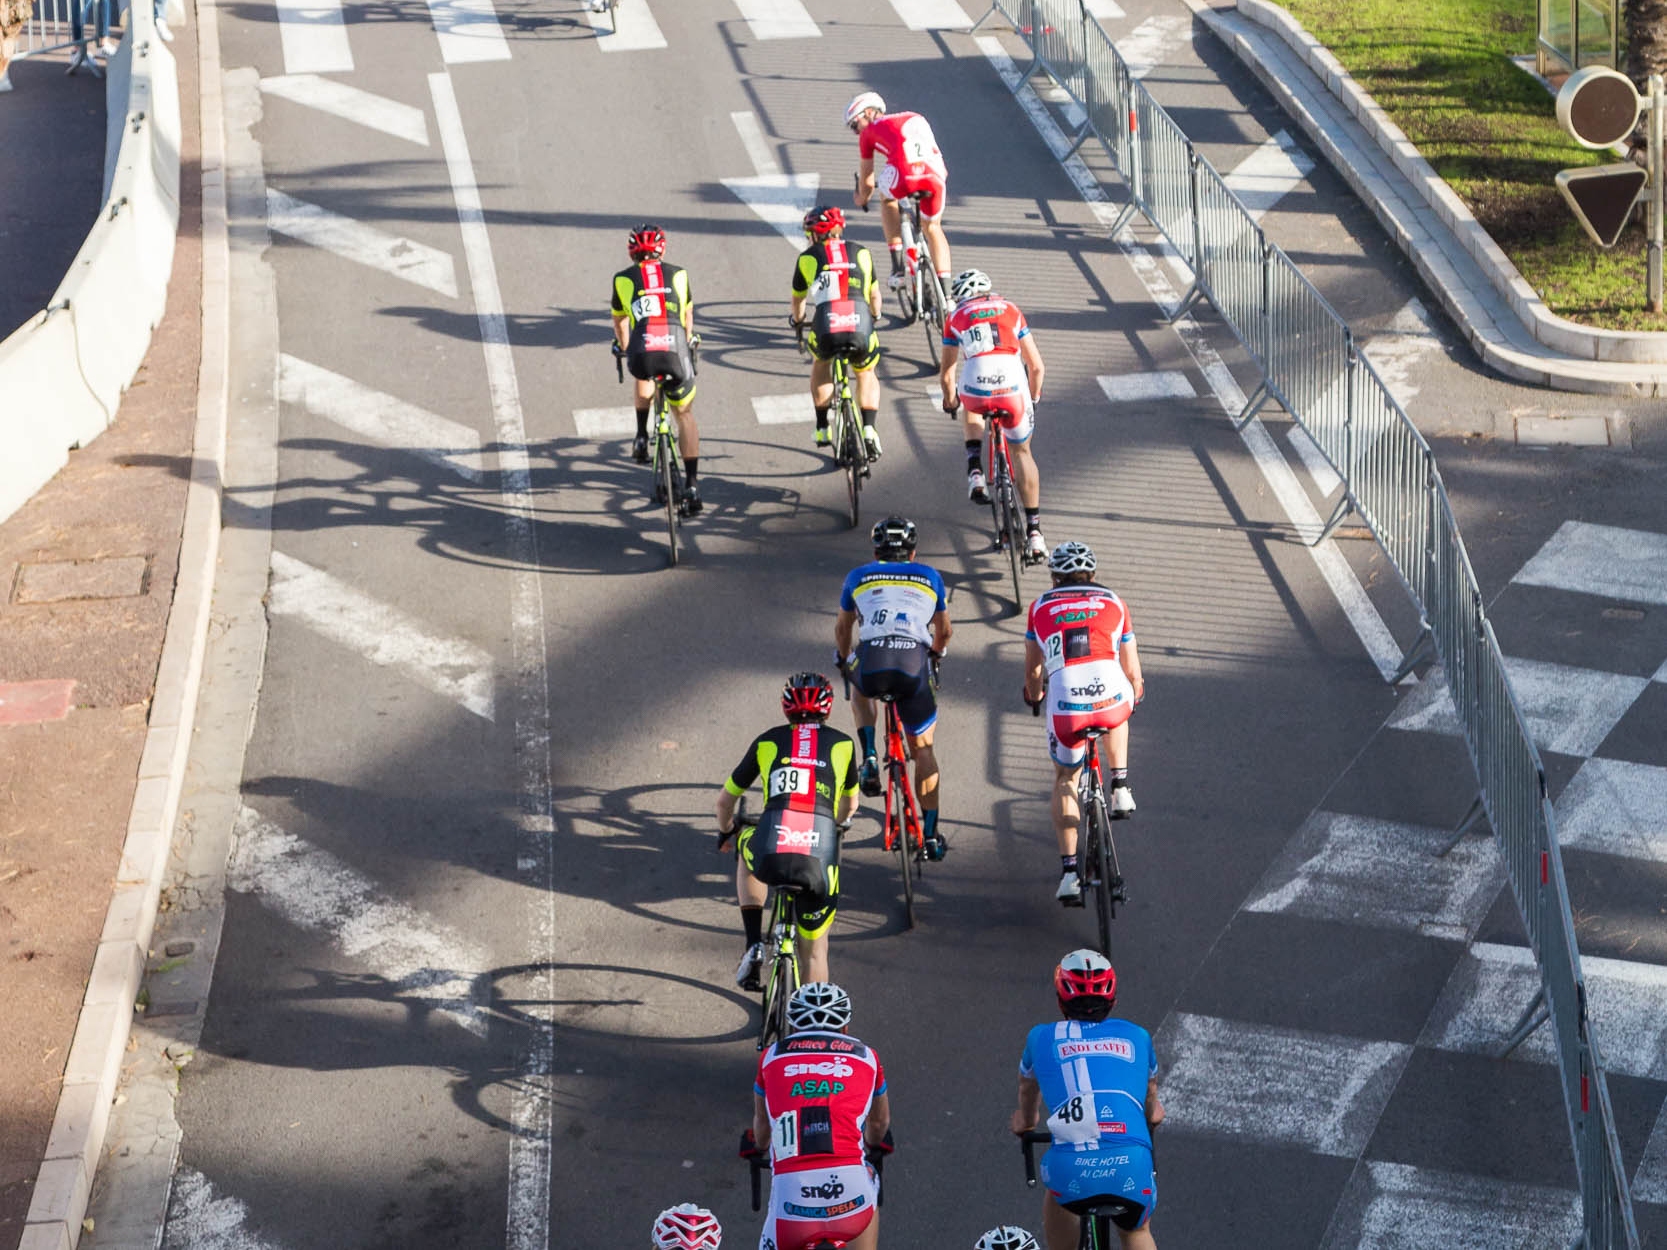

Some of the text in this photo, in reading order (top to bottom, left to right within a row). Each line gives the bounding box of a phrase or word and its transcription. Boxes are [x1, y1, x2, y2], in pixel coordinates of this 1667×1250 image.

[914, 143, 923, 158] 2
[968, 327, 982, 343] 16
[1048, 636, 1060, 659] 12
[1070, 680, 1106, 697] snep
[778, 770, 798, 792] 39
[775, 824, 820, 846] Deda
[784, 1058, 854, 1078] snep
[790, 1080, 845, 1097] ASAP
[1058, 1096, 1084, 1124] 48
[779, 1114, 795, 1148] 11
[1074, 1155, 1130, 1166] BIKE HOTEL
[801, 1178, 844, 1200] snep
